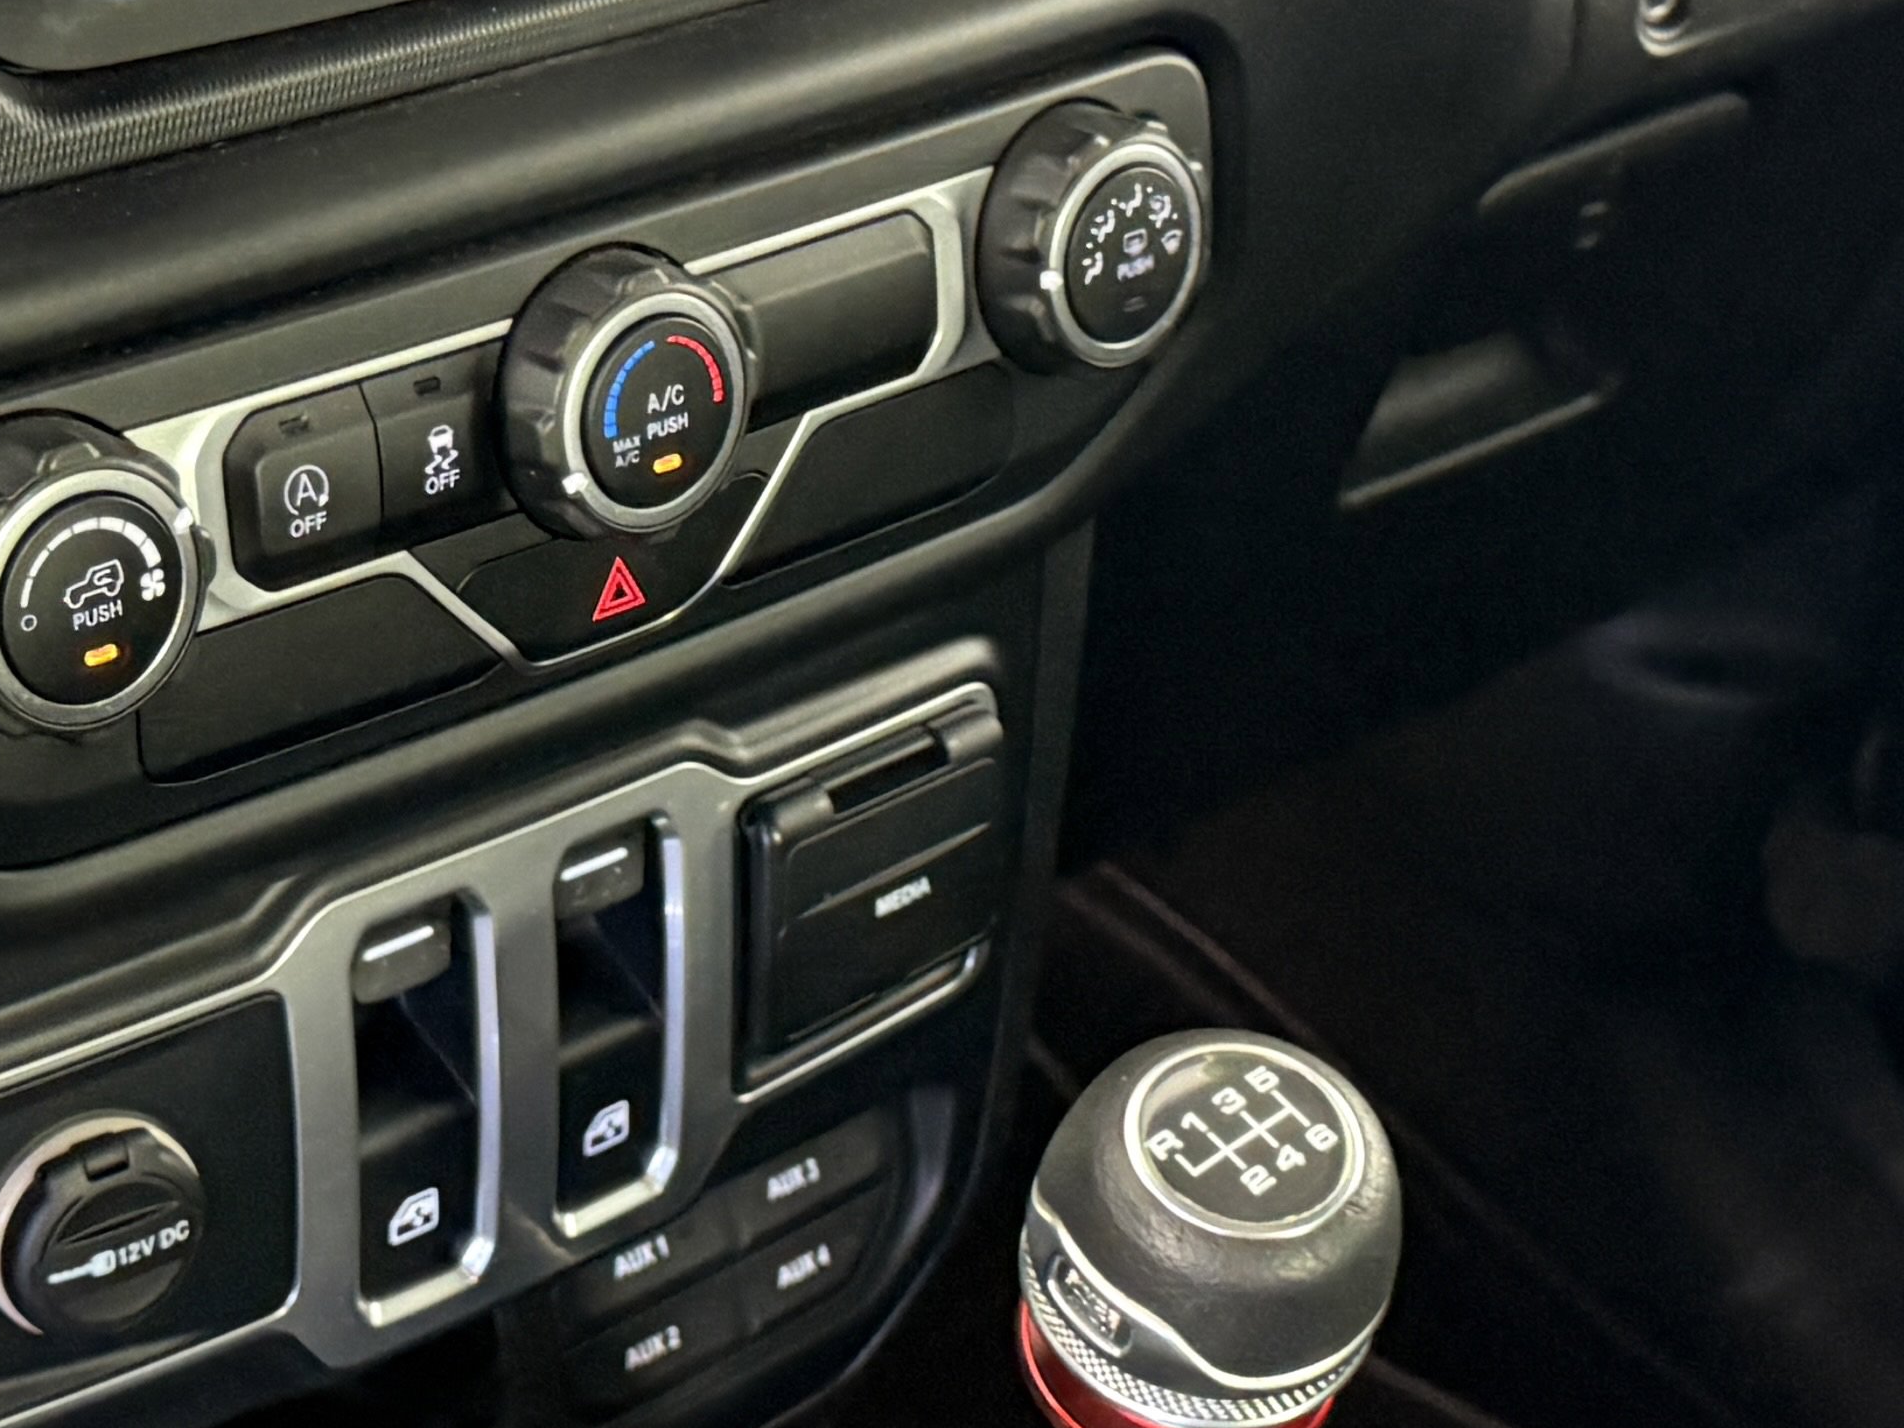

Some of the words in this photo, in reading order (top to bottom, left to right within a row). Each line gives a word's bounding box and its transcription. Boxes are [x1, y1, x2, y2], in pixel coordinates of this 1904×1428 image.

[647, 383, 685, 414] A/C
[647, 412, 689, 440] PUSH
[613, 435, 641, 453] MAX
[615, 450, 640, 468] A/C
[425, 470, 460, 494] OFF
[290, 512, 328, 538] OFF
[72, 600, 123, 630] PUSH
[1244, 1066, 1280, 1093] 5
[1211, 1087, 1246, 1115] 3
[1181, 1111, 1212, 1134] 1
[1145, 1128, 1183, 1162] R
[1304, 1123, 1339, 1152] 6
[1275, 1144, 1306, 1172] 4
[1240, 1163, 1277, 1197] 2
[118, 1234, 156, 1265] 12V
[159, 1219, 190, 1249] DC
[614, 1241, 657, 1279] AUX
[625, 1332, 667, 1370] AUX
